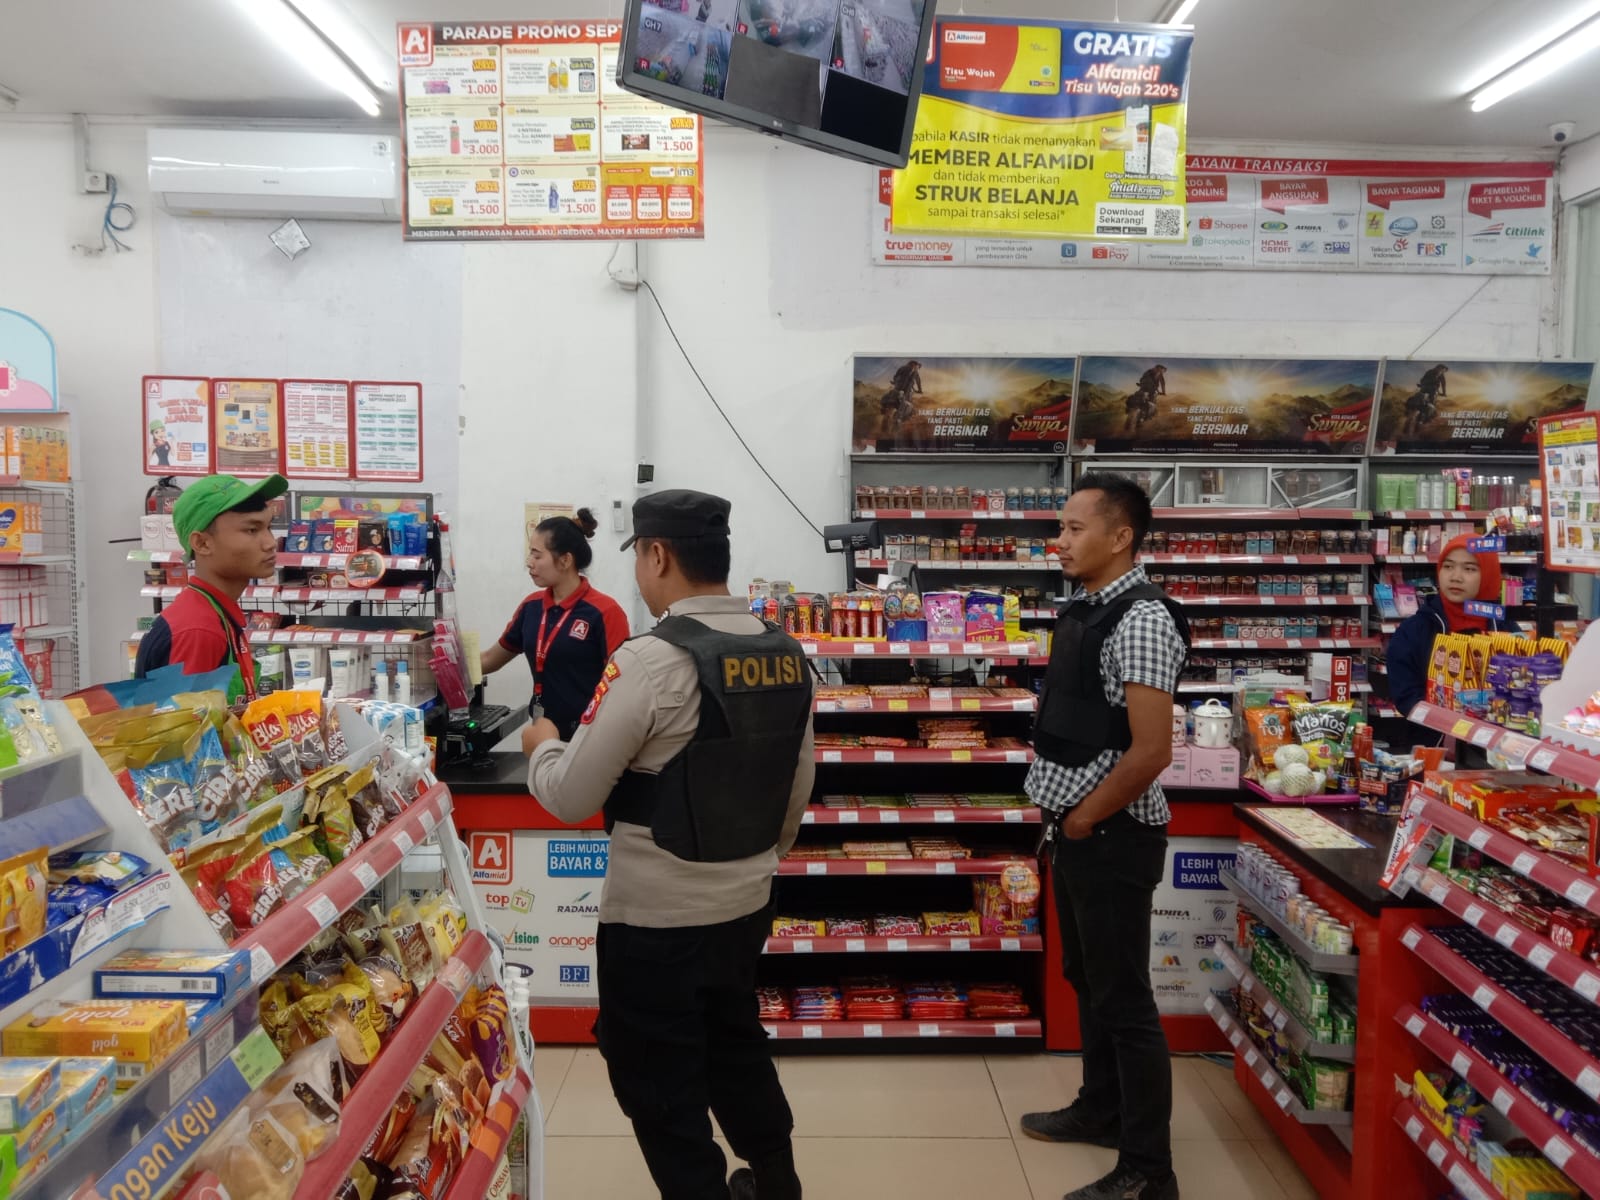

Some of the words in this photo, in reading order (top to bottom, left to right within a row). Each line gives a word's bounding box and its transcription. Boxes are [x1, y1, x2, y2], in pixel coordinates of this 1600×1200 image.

[443, 25, 512, 40] PARADE
[518, 24, 581, 39] PROMO
[956, 33, 985, 41] Alfamidi
[1073, 31, 1172, 58] GRATIS
[945, 67, 964, 76] Tisu
[967, 68, 995, 79] Wajah
[1087, 63, 1160, 82] Alfamidi
[467, 84, 497, 94] 1.000
[1065, 80, 1093, 94] Tisu
[1097, 81, 1141, 97] Wajah
[1144, 83, 1179, 98] 220's
[950, 130, 990, 144] KASIR
[993, 132, 1021, 145] tidak
[1023, 135, 1096, 150] menanyakan
[469, 144, 499, 154] 3.000
[663, 141, 693, 151] 1.500
[909, 149, 991, 167] MEMBER
[996, 151, 1095, 170] ALFAMIDI
[1243, 158, 1328, 172] TRANSAKSI
[933, 170, 956, 181] dan
[958, 170, 990, 182] tidak
[991, 171, 1060, 185] memberikan
[1280, 182, 1307, 190] BAYAR
[1371, 186, 1400, 196] BAYAR
[1402, 185, 1440, 194] TAGIHAN
[1483, 185, 1530, 195] PEMBELIAN
[915, 185, 983, 203] STRUK
[988, 187, 1080, 206] BELANJA
[1192, 188, 1225, 197] ONLINE
[1269, 191, 1319, 201] ANGSURAN
[469, 205, 499, 215] 1.500
[566, 203, 596, 213] 1.500
[928, 206, 967, 221] sampai
[968, 206, 1021, 220] transaksi
[1099, 207, 1145, 217] Download
[1099, 215, 1144, 226] Sekarang!
[1214, 220, 1248, 230] Shopee
[411, 230, 454, 238] MENERIMA
[457, 229, 512, 237] PEMBAYARAN
[635, 227, 662, 235] KREDIT
[1505, 226, 1546, 237] Citilink
[1261, 239, 1289, 247] HOME
[1261, 246, 1292, 254] CREDIT
[935, 408, 991, 417] BERKUALITAS
[1188, 405, 1244, 414] BERKUALITAS
[1456, 410, 1509, 419] BERKUALITAS
[927, 417, 944, 425] YANG
[1206, 415, 1224, 423] PASTI
[1466, 419, 1482, 427] PASTI
[933, 424, 989, 437] BERSINAR
[1011, 415, 1069, 438] Surya
[1192, 423, 1249, 436] BERSINAR
[1307, 414, 1367, 439] Surya
[1452, 426, 1505, 439] BERSINAR
[335, 542, 356, 553] Sutra
[723, 655, 804, 688] POLISI
[549, 843, 576, 854] LEBIH
[551, 856, 591, 871] BAYAR
[594, 856, 604, 870] &
[1181, 858, 1213, 870] LEBIH
[473, 870, 507, 880] Alfamidi
[1181, 873, 1218, 884] BAYAR
[486, 892, 510, 909] top
[556, 905, 599, 913] RADANA
[549, 936, 595, 951] orange
[562, 967, 589, 981] BFI
[92, 1033, 119, 1052] gold
[163, 1095, 217, 1151] Keju
